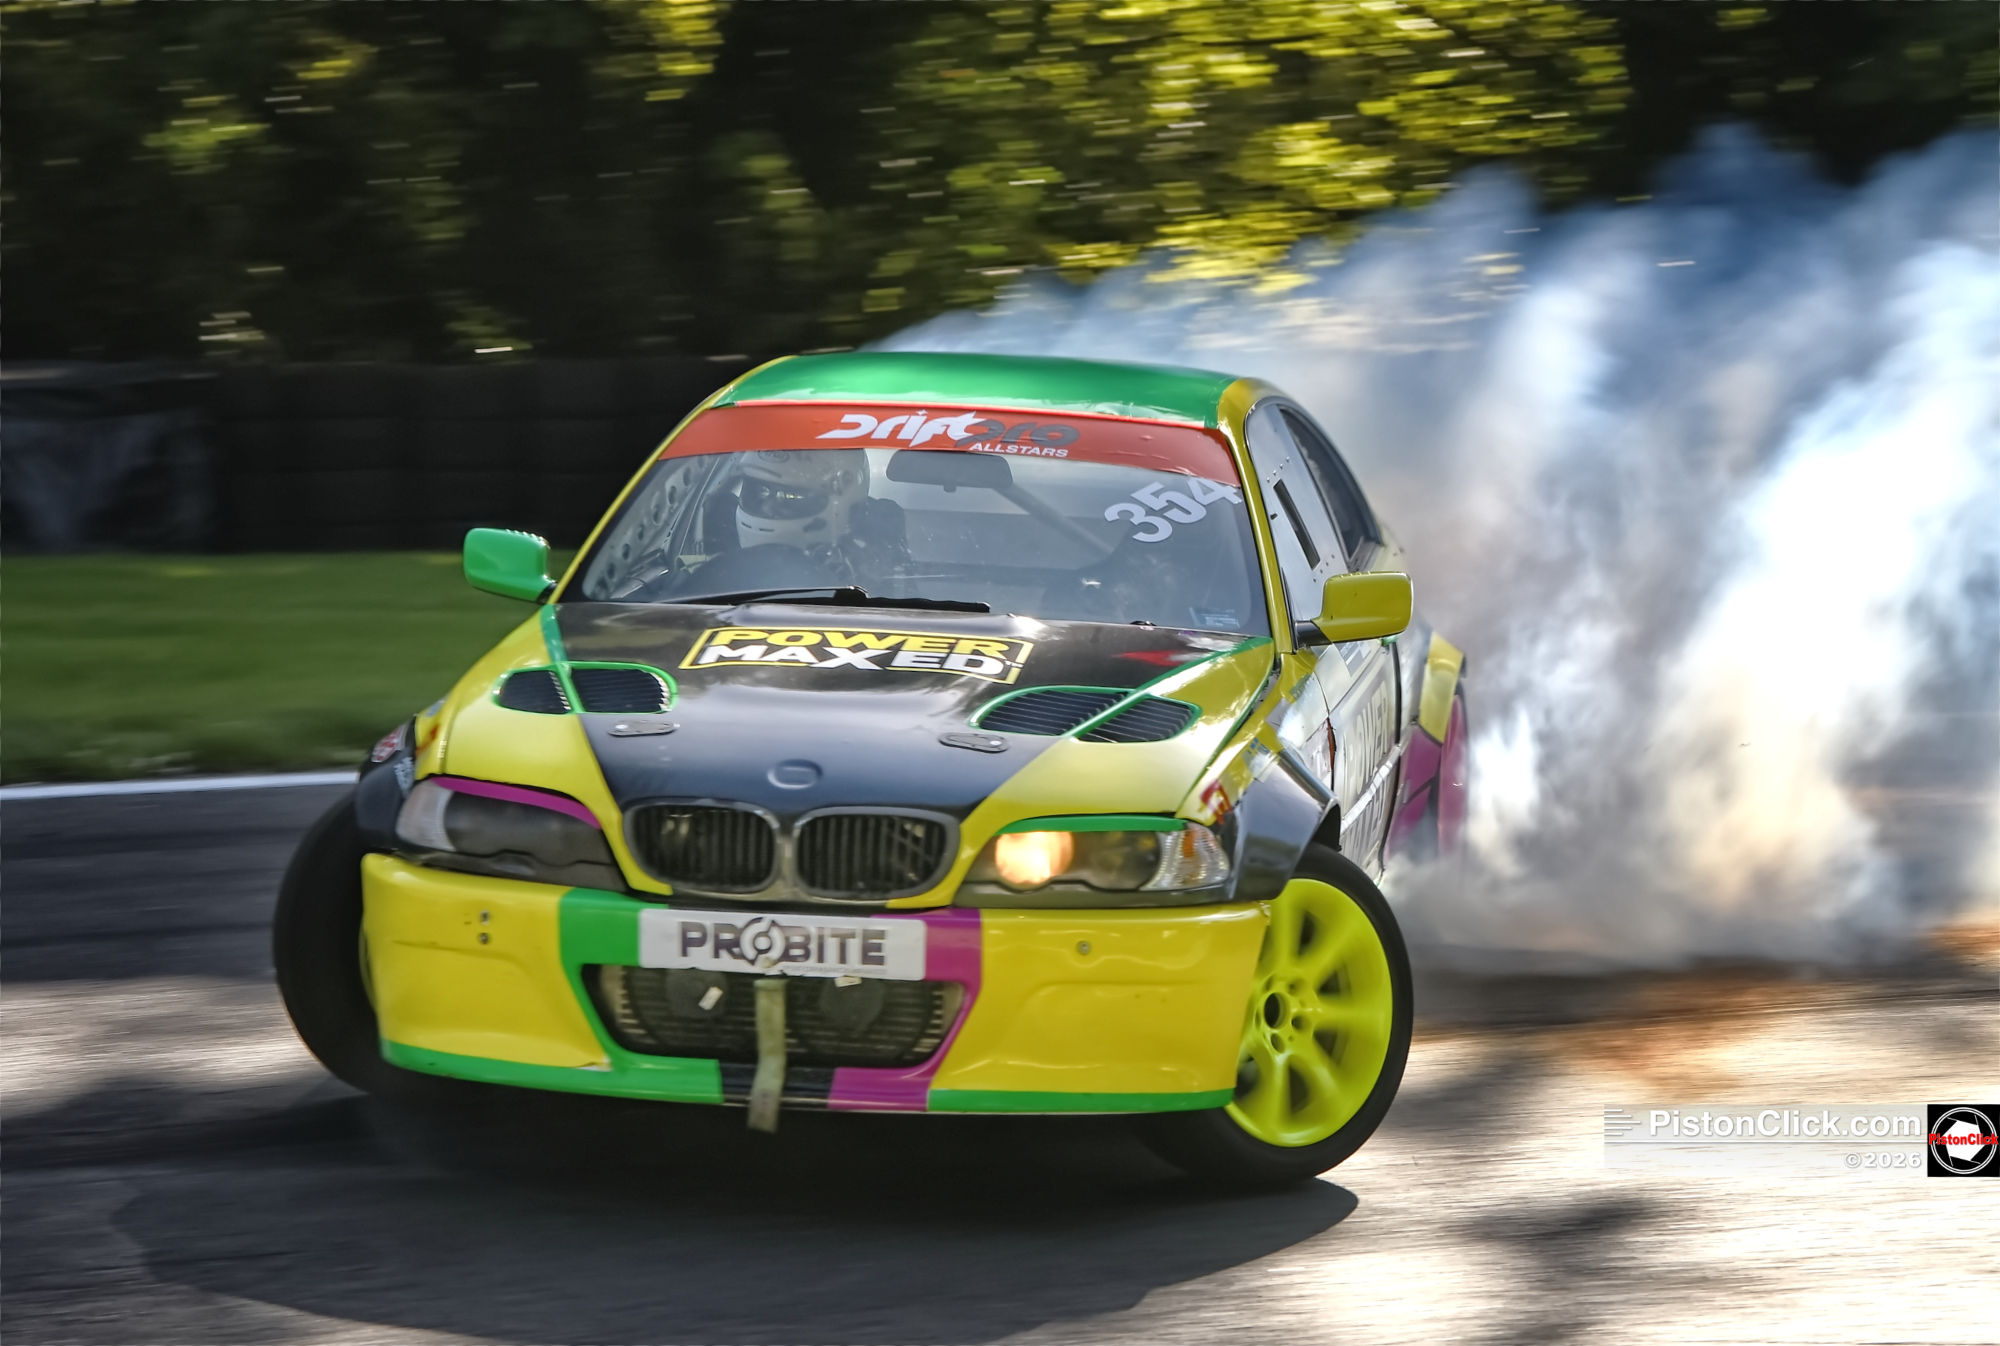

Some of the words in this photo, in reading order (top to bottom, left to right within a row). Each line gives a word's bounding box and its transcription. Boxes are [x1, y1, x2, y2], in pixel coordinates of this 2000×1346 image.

[968, 442, 1068, 458] ALLSTARS
[1104, 476, 1243, 543] 354
[698, 644, 1006, 675] MAXED
[710, 630, 1010, 660] POWER
[681, 916, 887, 966] PROBITE
